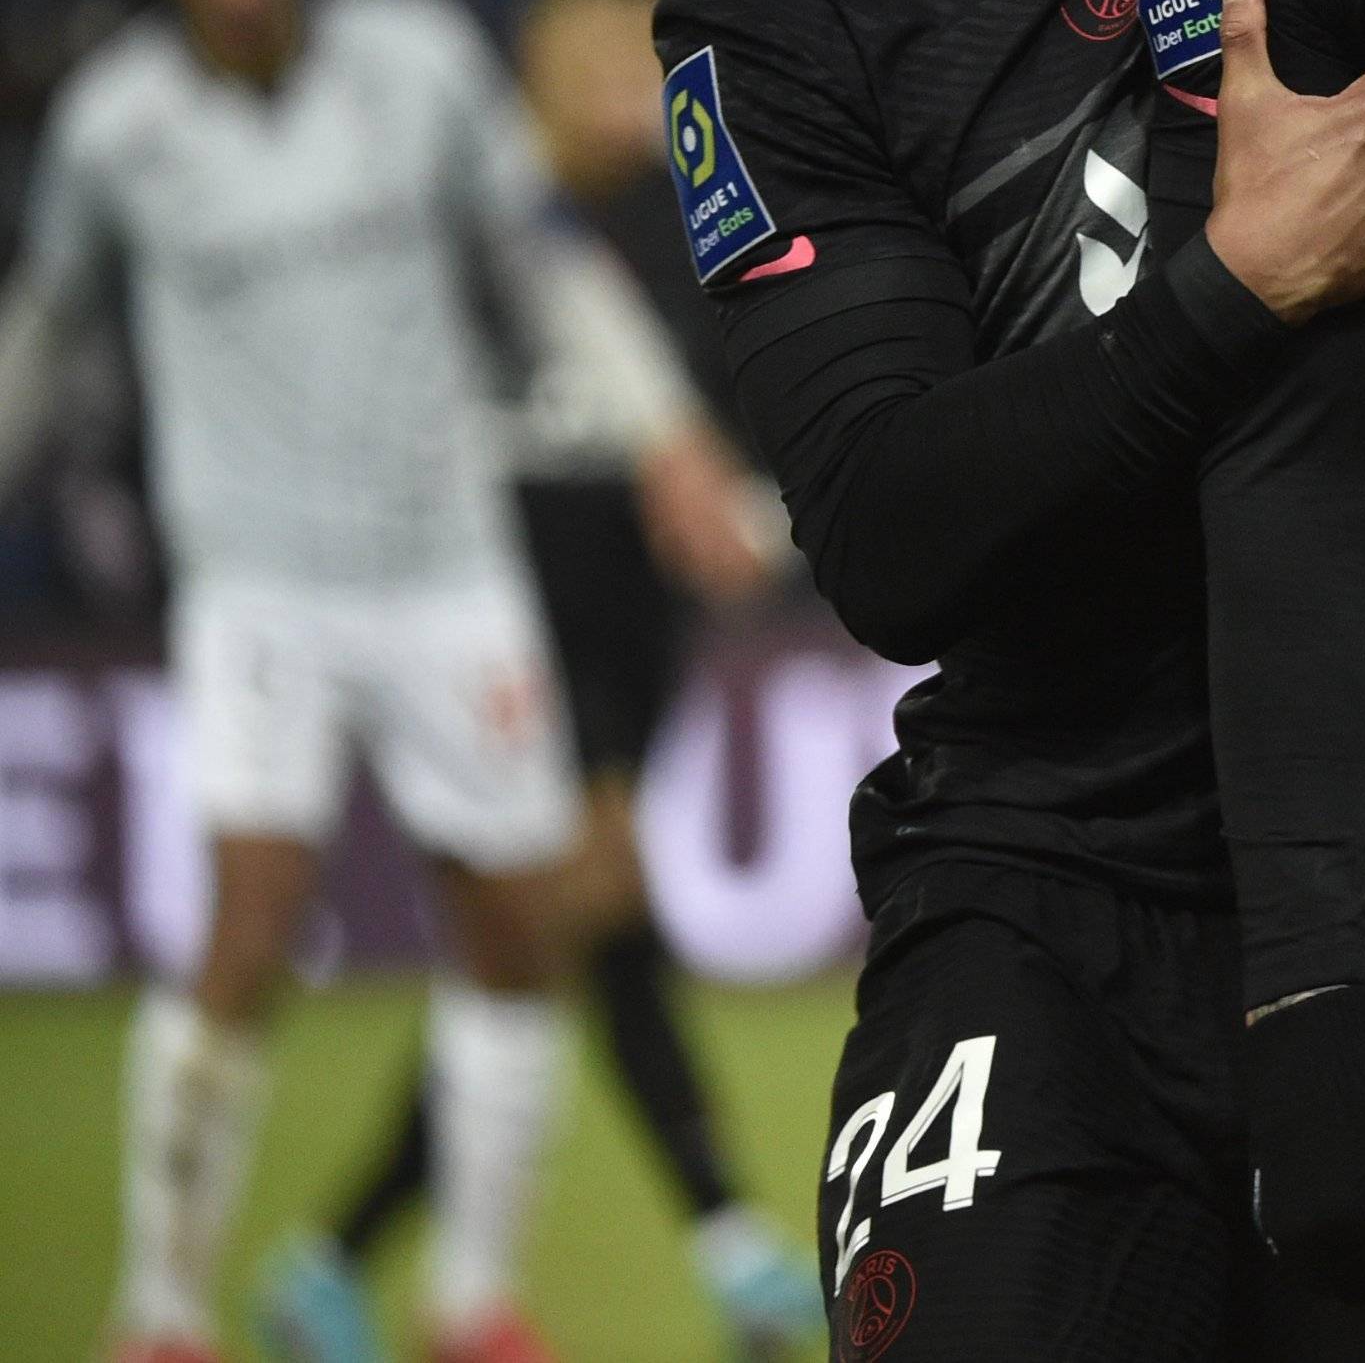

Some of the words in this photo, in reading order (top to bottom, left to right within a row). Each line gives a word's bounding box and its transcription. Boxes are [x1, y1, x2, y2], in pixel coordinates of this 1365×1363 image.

[1153, 28, 1183, 53] Uber
[690, 188, 729, 230] LIGUE
[727, 181, 738, 197] 1
[718, 207, 754, 237] Eats
[827, 1035, 1002, 1298] 24
